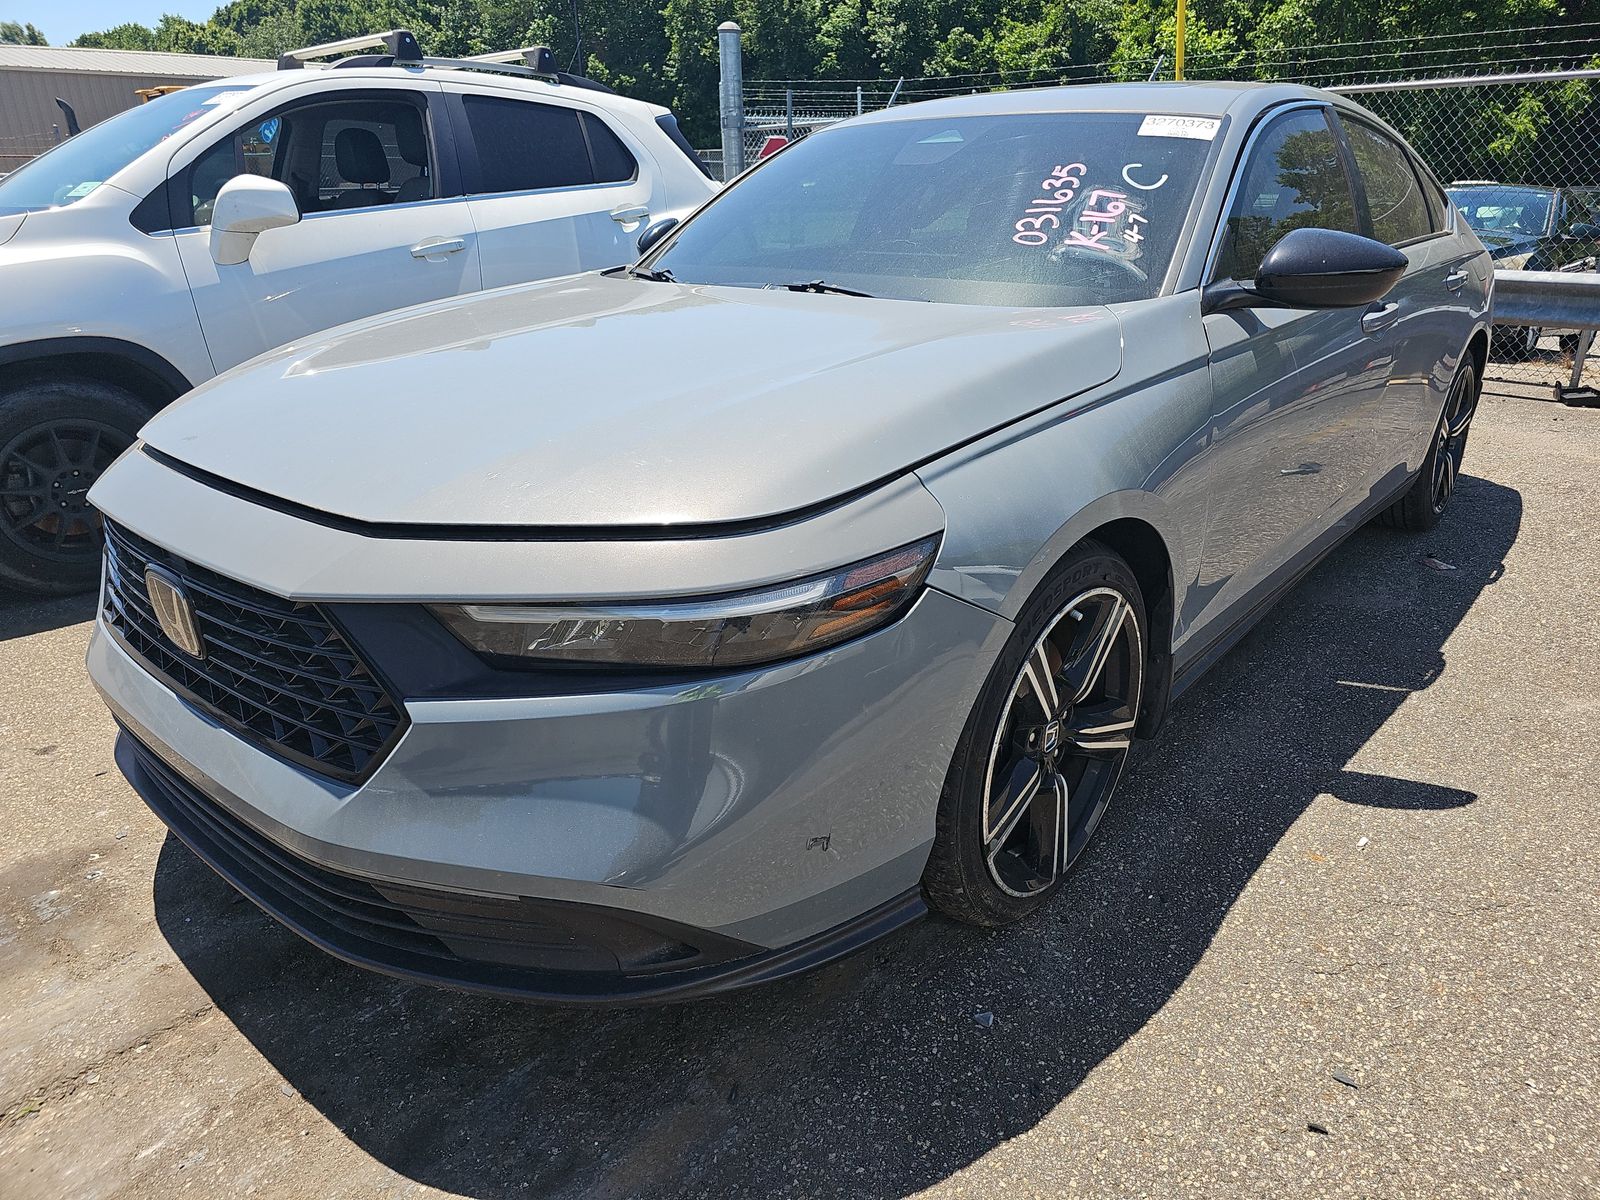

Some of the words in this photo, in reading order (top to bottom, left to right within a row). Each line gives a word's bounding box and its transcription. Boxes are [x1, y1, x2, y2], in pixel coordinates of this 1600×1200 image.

[1145, 117, 1214, 130] 3270373
[1121, 162, 1169, 191] C
[1012, 162, 1088, 246] 031635
[1064, 190, 1128, 250] K-167
